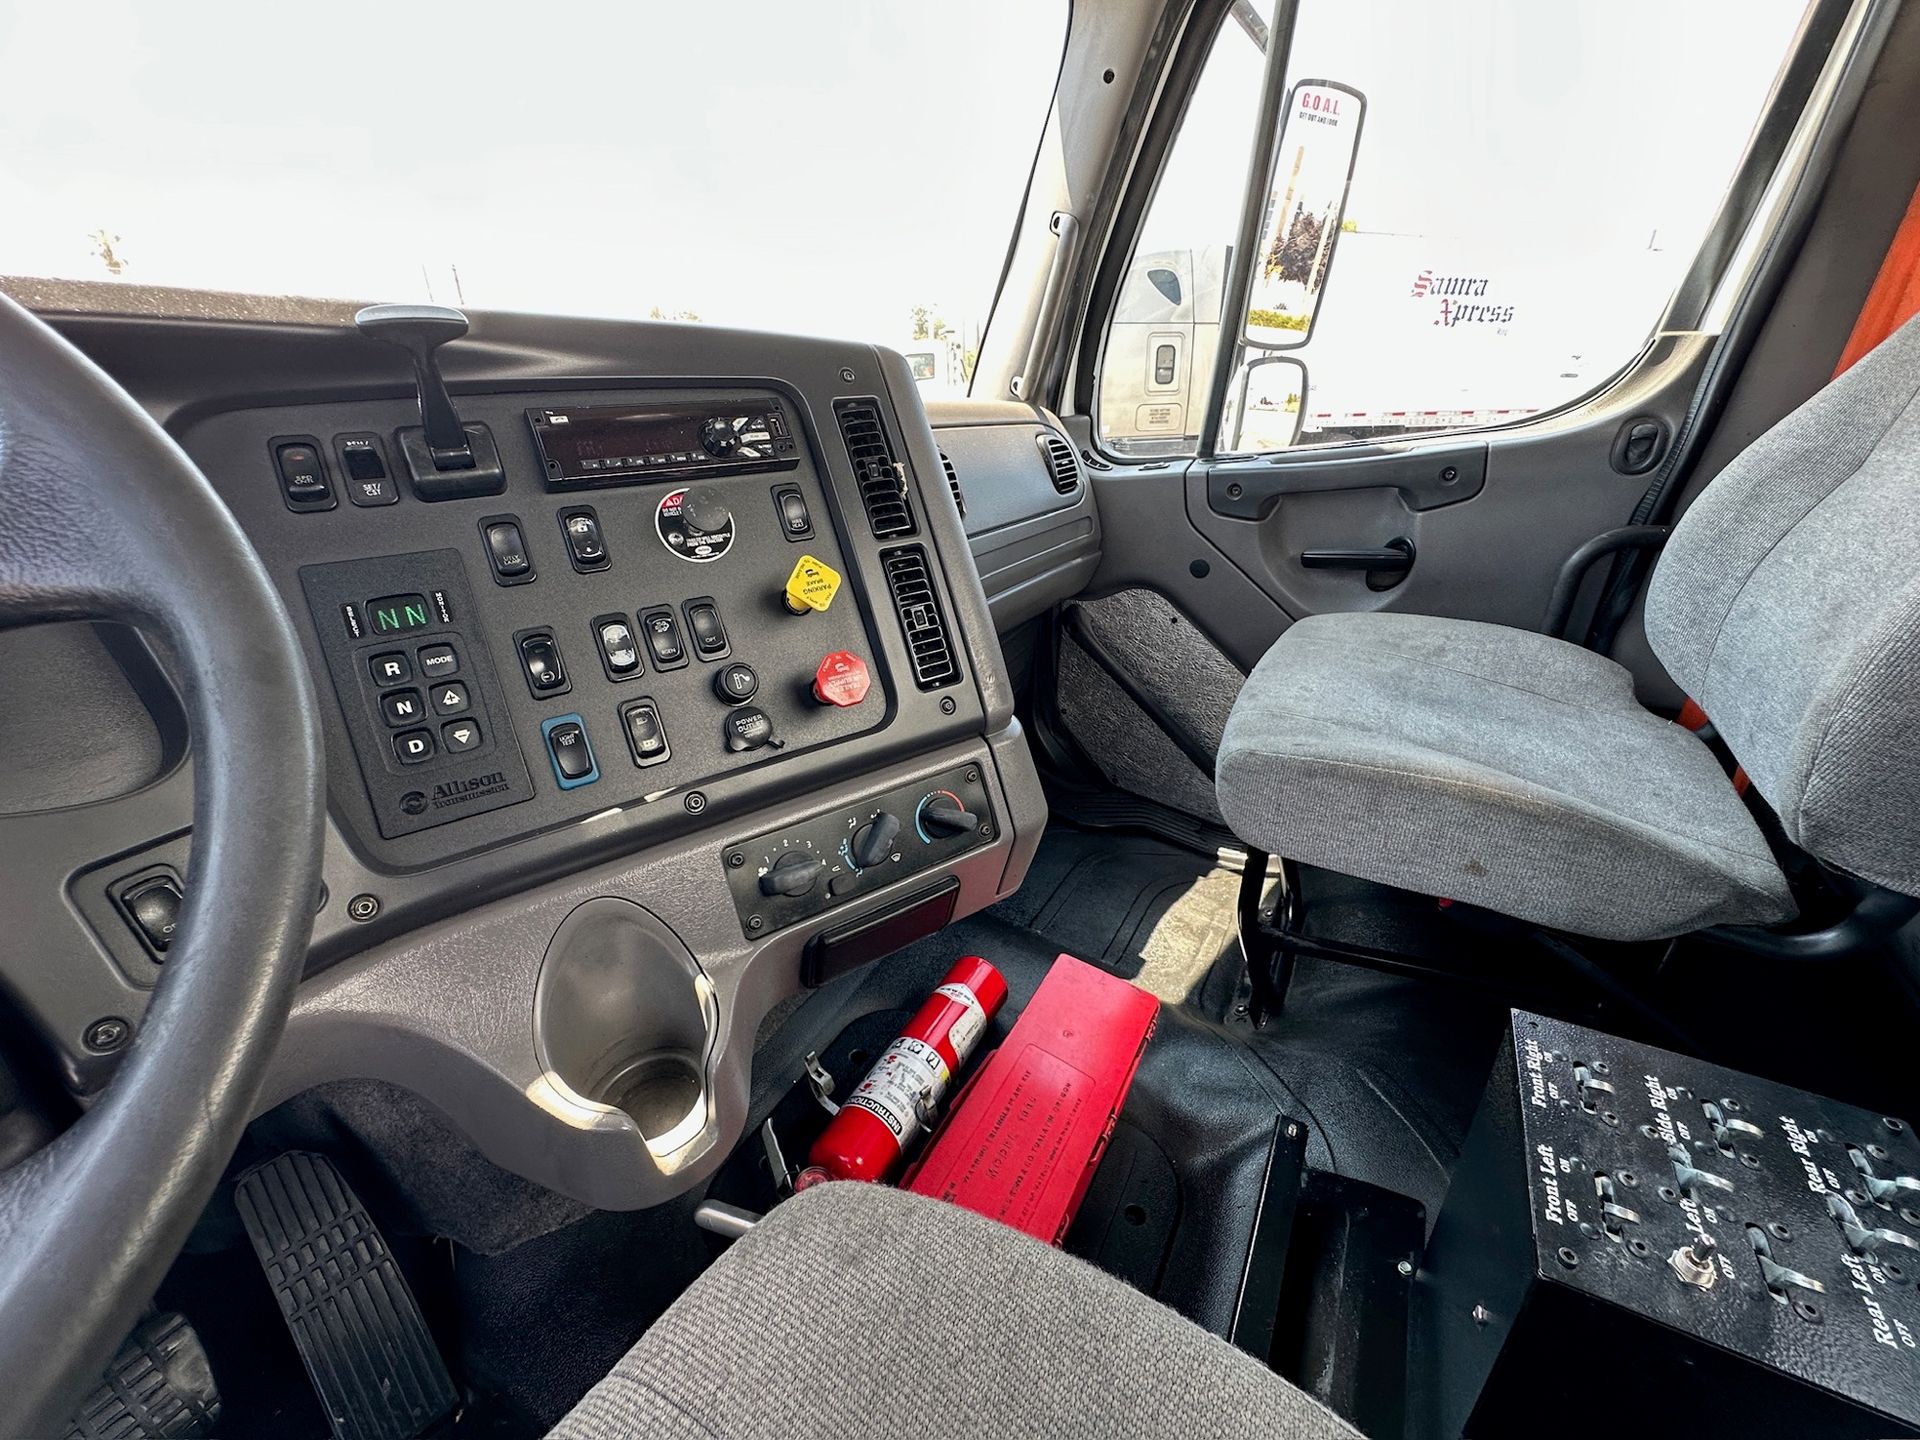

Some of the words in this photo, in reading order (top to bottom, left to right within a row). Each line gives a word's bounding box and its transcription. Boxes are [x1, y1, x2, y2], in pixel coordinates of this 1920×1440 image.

[1302, 92, 1340, 115] G.O.A.L.
[1411, 270, 1488, 298] Samra
[1433, 299, 1515, 328] Xpress
[803, 584, 832, 594] PARKING
[346, 606, 360, 637] SELECT
[435, 592, 450, 623] MONITOR
[384, 662, 401, 676] R
[426, 655, 453, 665] MODE
[396, 701, 413, 714] N
[736, 714, 762, 726] POWER
[738, 720, 763, 732] OUTLET
[408, 739, 424, 753] D
[432, 772, 507, 800] Allison
[1525, 1038, 1543, 1072] Right
[1529, 1072, 1547, 1108] Front
[1548, 1082, 1558, 1099] OFF
[1644, 1075, 1667, 1111] Right
[1655, 1112, 1677, 1145] Side
[1676, 1121, 1691, 1140] OFF
[1779, 1116, 1811, 1157] Right
[1537, 1144, 1556, 1176] Left
[1559, 1157, 1571, 1173] ON
[1800, 1157, 1826, 1194] Rear
[1822, 1167, 1840, 1189] OFF
[1542, 1177, 1563, 1225] Front
[1565, 1199, 1579, 1222] OFF
[1703, 1206, 1718, 1223] ON
[1679, 1198, 1704, 1234] Left
[1717, 1253, 1735, 1279] OFF
[1840, 1253, 1874, 1295] Left
[1867, 1264, 1886, 1284] ON
[1862, 1296, 1898, 1349] Rear
[1893, 1318, 1916, 1348] OFF
